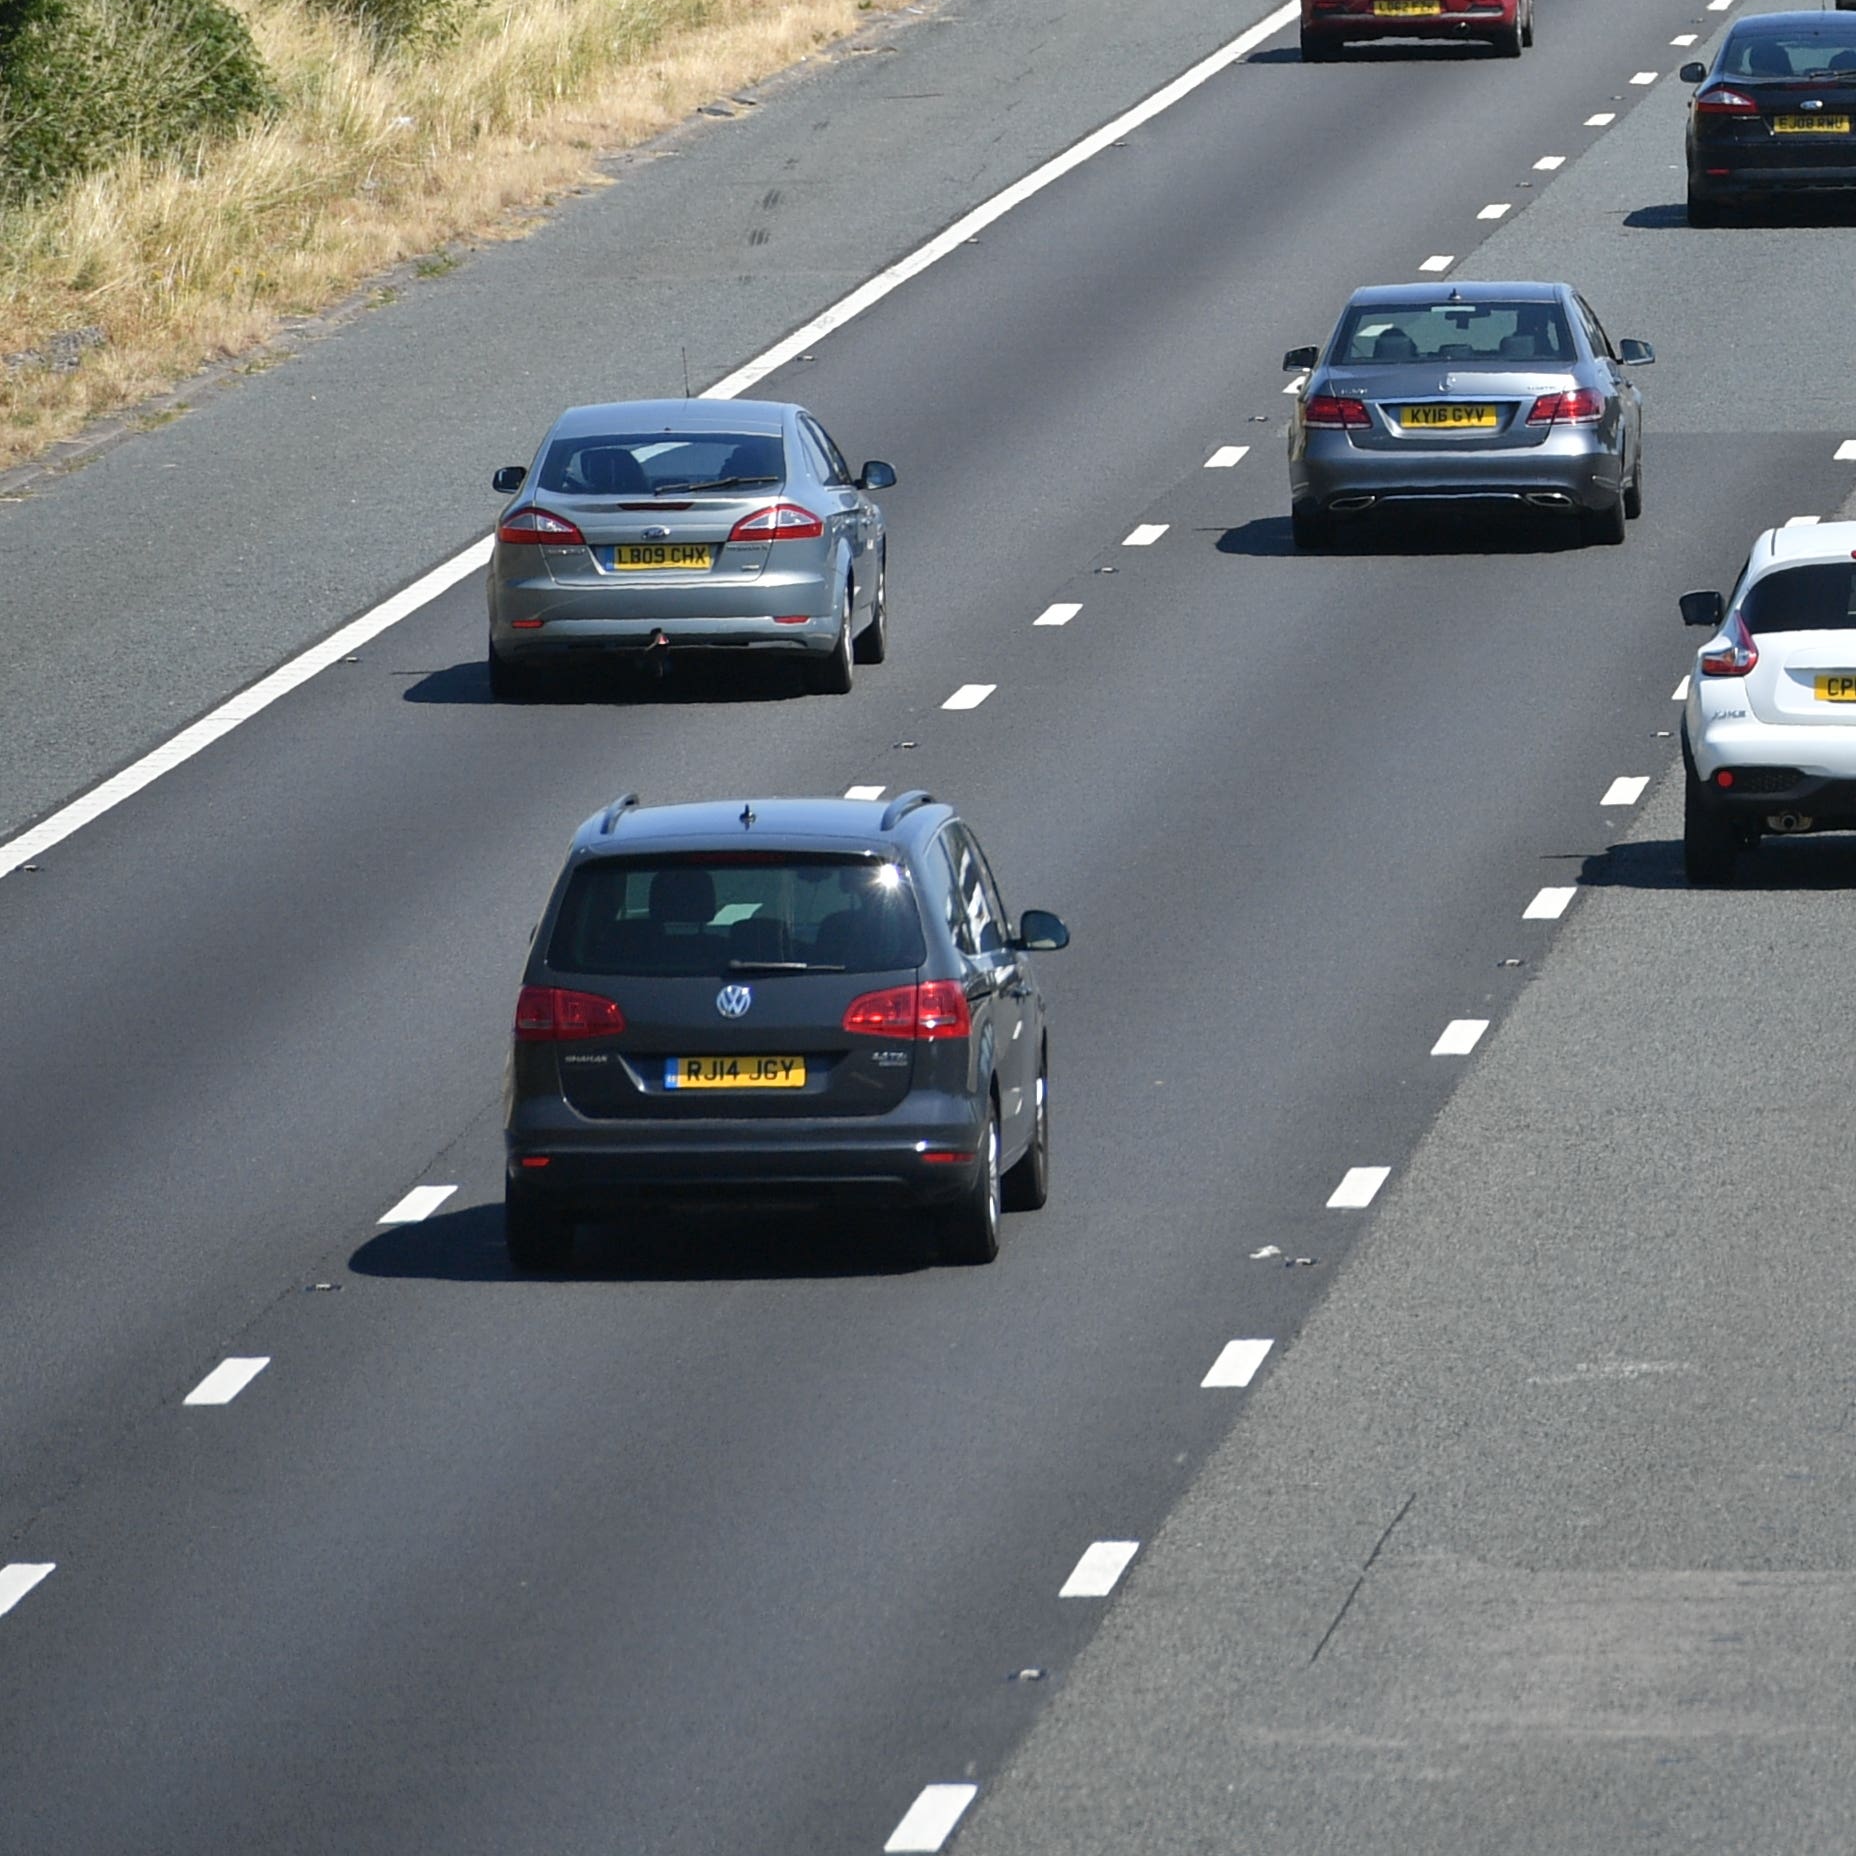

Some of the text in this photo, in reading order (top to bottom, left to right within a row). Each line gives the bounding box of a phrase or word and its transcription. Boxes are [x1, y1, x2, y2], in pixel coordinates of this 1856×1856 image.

[1413, 408, 1486, 424] KY16 GYV
[617, 545, 706, 565] LB09 CHX
[687, 1059, 795, 1081] RJ14 JGY
